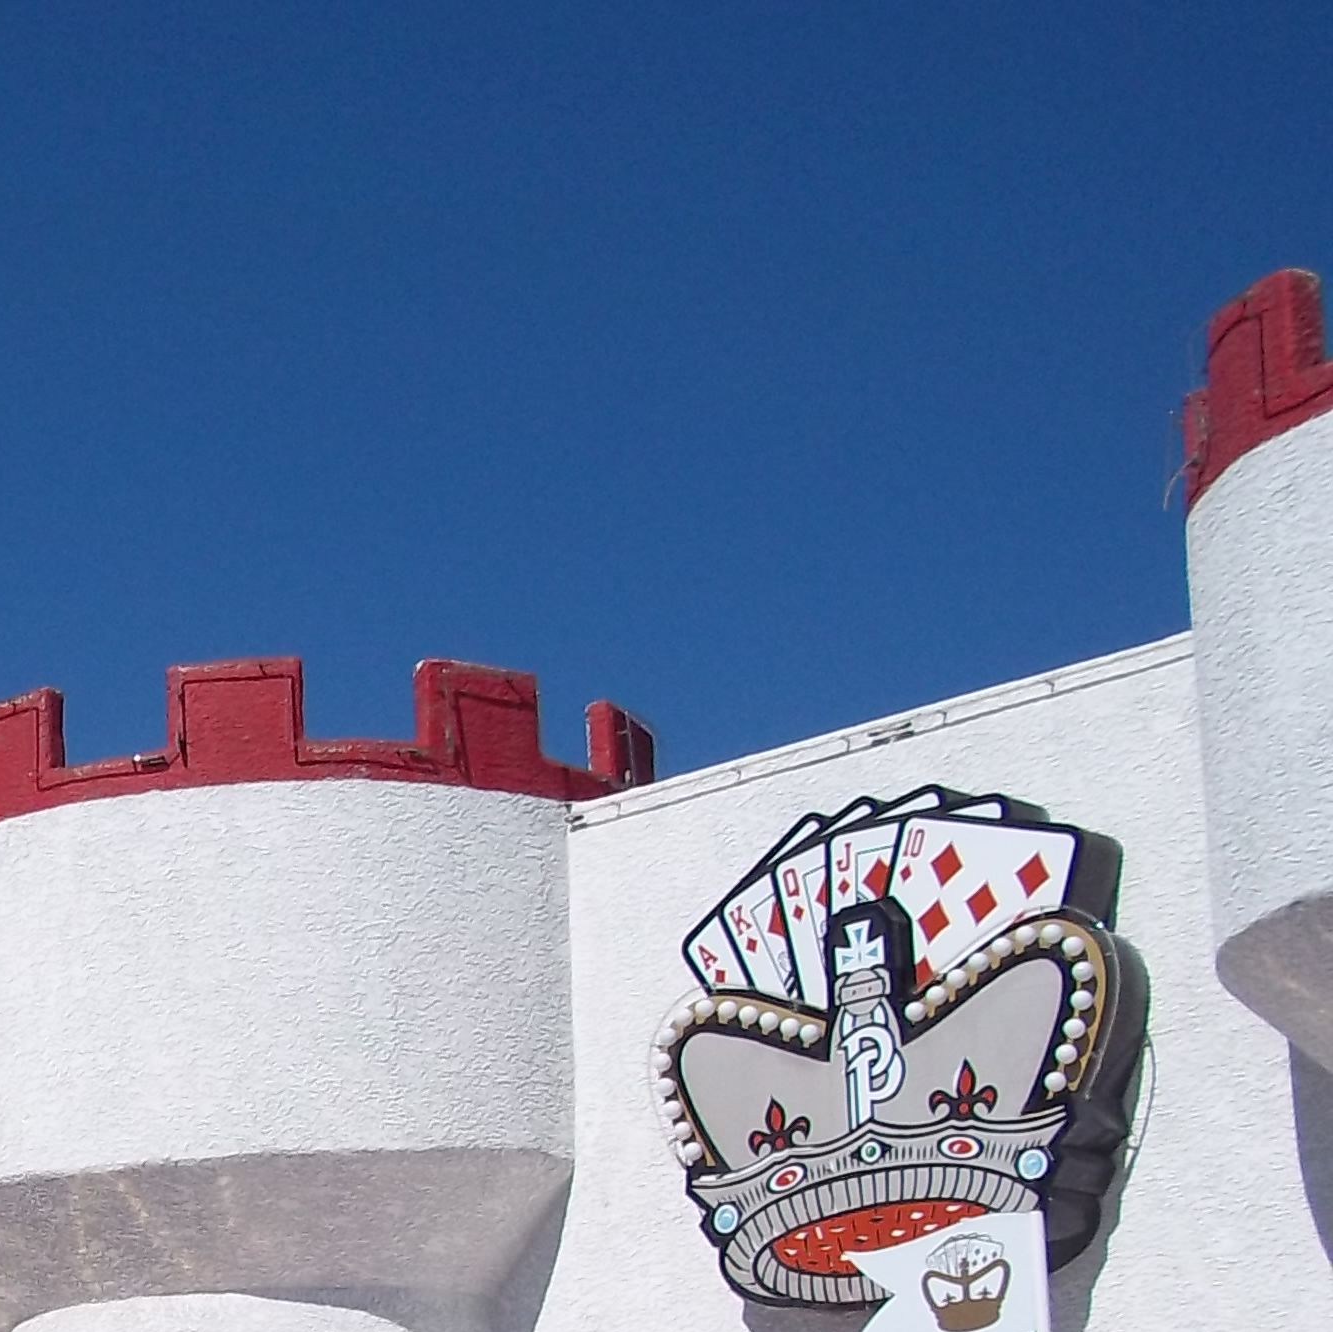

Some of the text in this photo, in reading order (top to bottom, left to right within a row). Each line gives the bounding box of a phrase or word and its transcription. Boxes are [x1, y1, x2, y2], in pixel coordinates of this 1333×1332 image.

[836, 842, 852, 872] J
[902, 827, 926, 858] 10
[783, 867, 801, 898] Q
[729, 904, 752, 936] K
[698, 945, 719, 971] A
